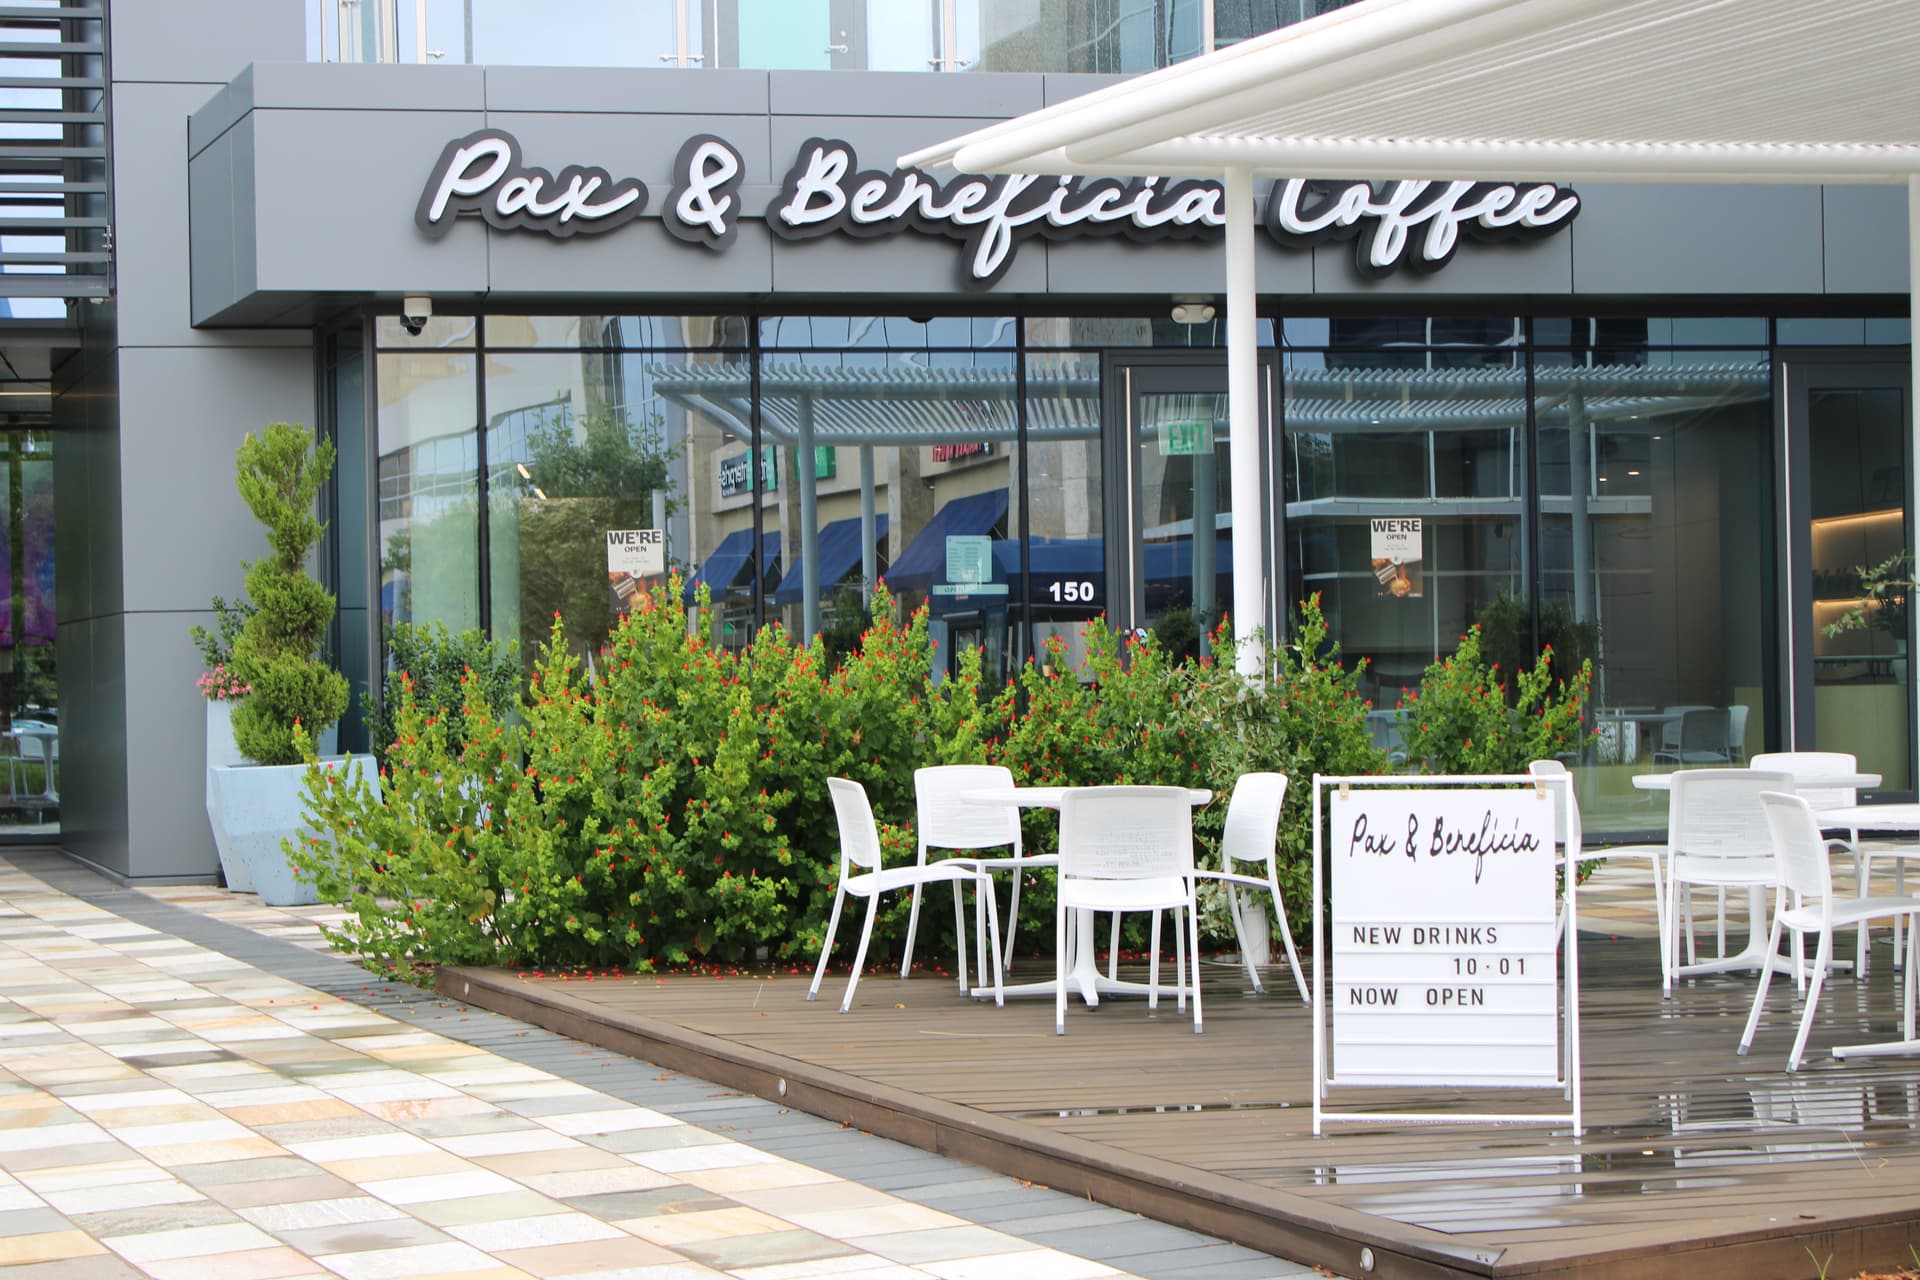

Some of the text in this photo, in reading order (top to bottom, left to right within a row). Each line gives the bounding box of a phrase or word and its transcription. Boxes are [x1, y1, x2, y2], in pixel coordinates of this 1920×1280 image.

[429, 138, 1578, 278] Pax & Beneficia Coffee
[1167, 422, 1205, 452] EXIT
[1372, 520, 1421, 533] WE'RE
[608, 531, 661, 545] WE'RE
[1049, 581, 1094, 602] 150
[1350, 809, 1540, 885] Pax & Beneficia
[1353, 926, 1498, 945] NEW DRINKS
[1350, 987, 1484, 1006] NOW OPEN
